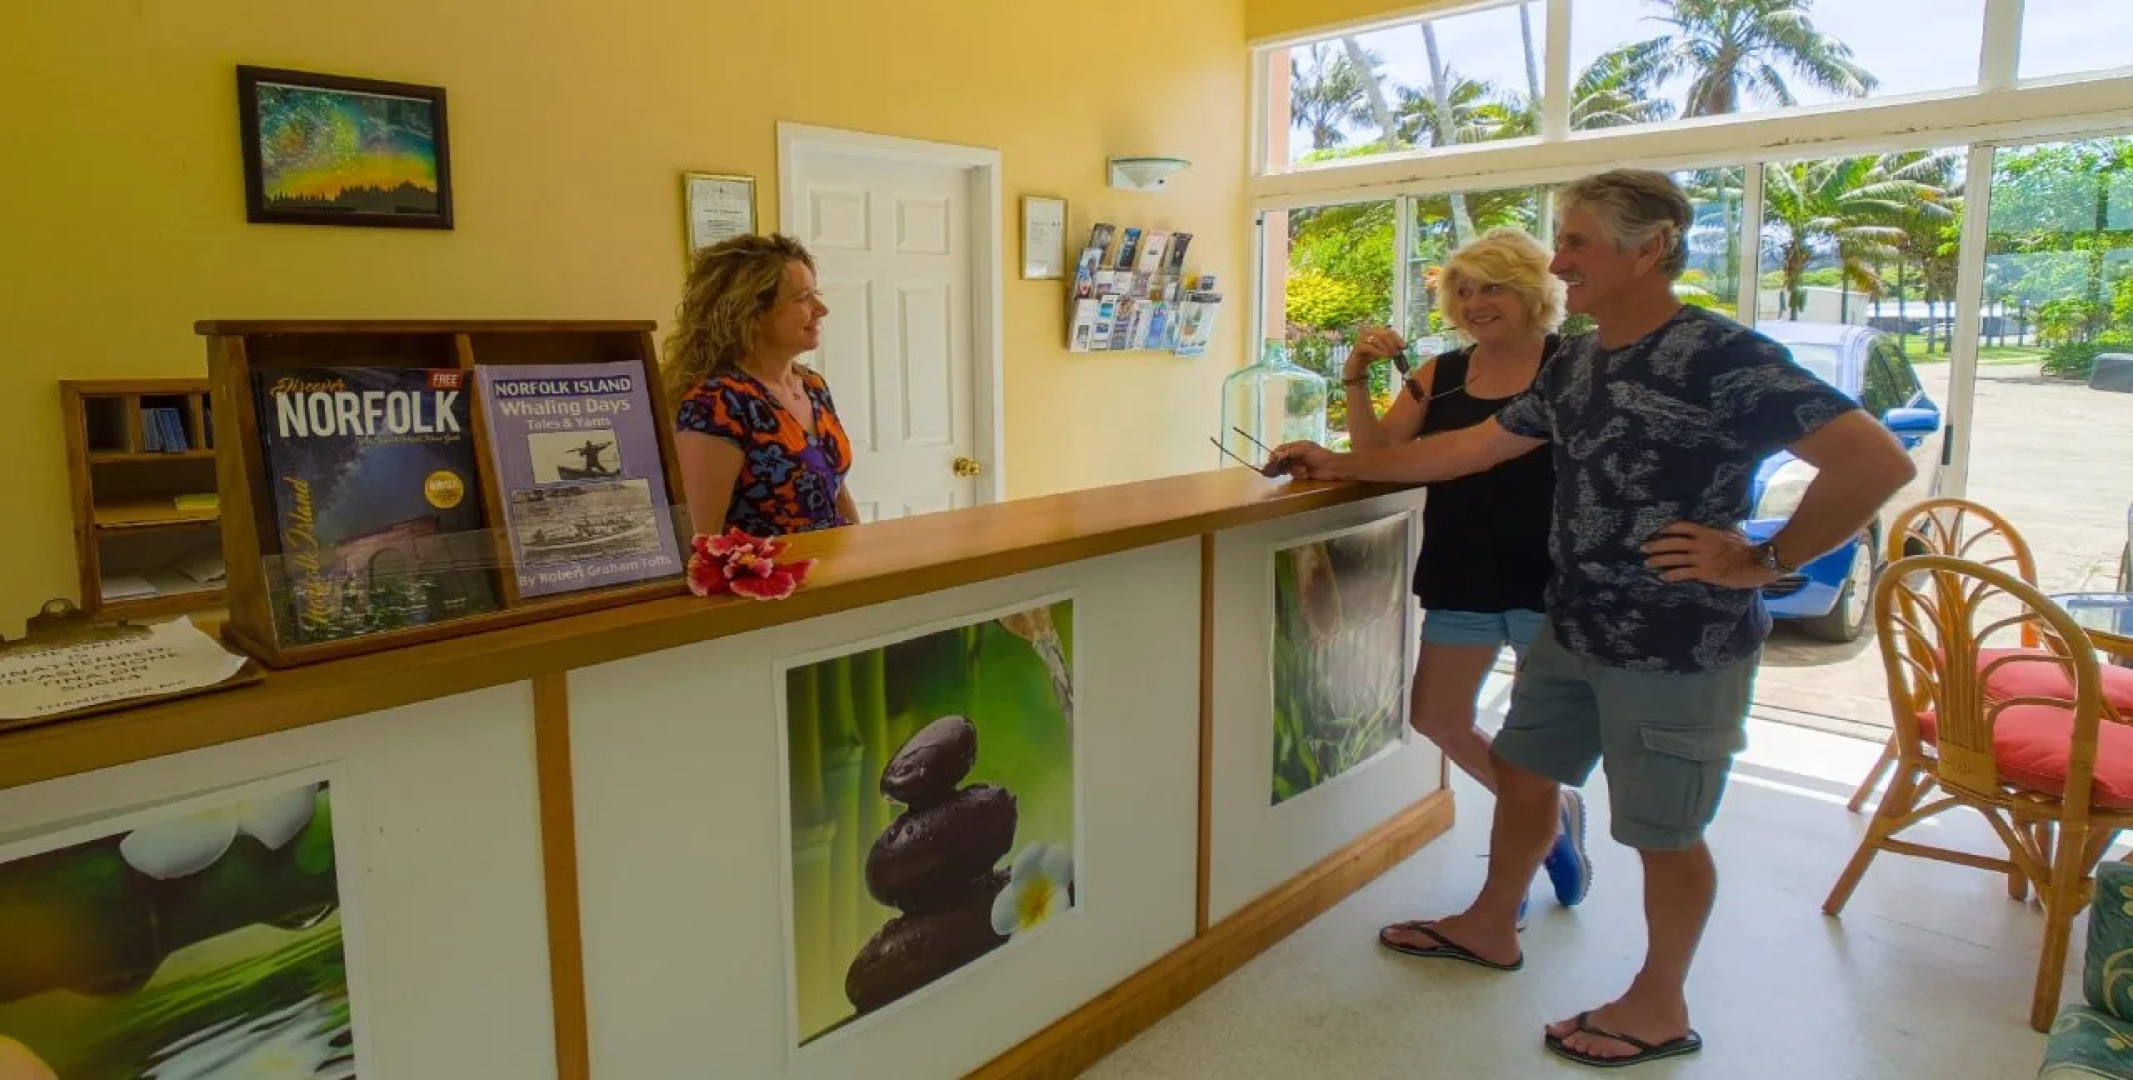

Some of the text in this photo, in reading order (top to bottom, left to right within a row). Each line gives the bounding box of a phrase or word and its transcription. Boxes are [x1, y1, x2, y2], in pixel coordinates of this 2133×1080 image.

[433, 374, 458, 387] FREE
[494, 378, 631, 396] NORFOLK ISLAND
[276, 390, 461, 437] NORFOLK
[501, 398, 631, 416] Whaling Days
[527, 416, 612, 430] Tales & Yarns
[519, 576, 536, 586] By
[540, 566, 585, 584] Robert
[588, 561, 639, 576] Graham
[43, 665, 148, 688] TINA ON
